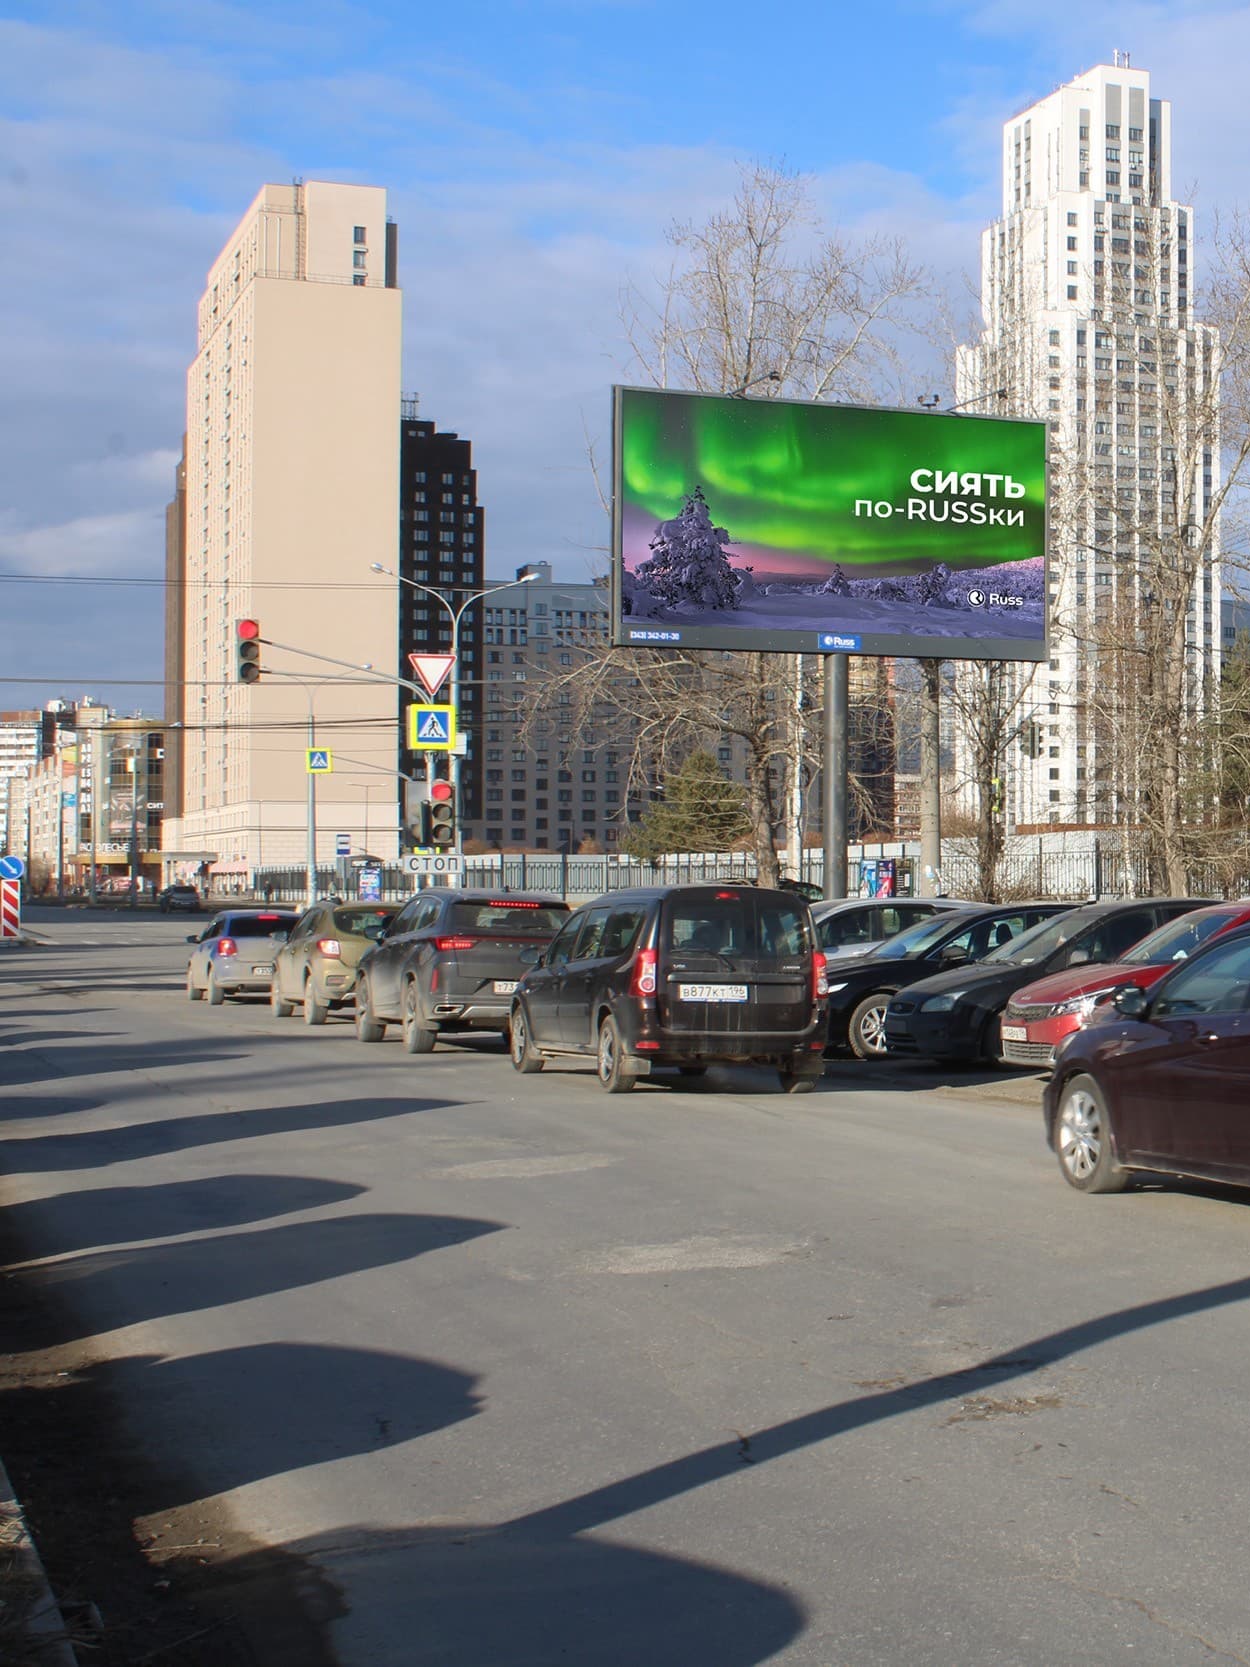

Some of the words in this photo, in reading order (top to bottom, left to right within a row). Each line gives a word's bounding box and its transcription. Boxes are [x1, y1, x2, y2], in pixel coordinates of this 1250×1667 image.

[910, 469, 1026, 498] СИЯТЬ
[855, 499, 1024, 526] по-RUSSки
[989, 593, 1023, 606] Russ
[834, 636, 855, 646] Russ
[409, 857, 459, 872] СТОП
